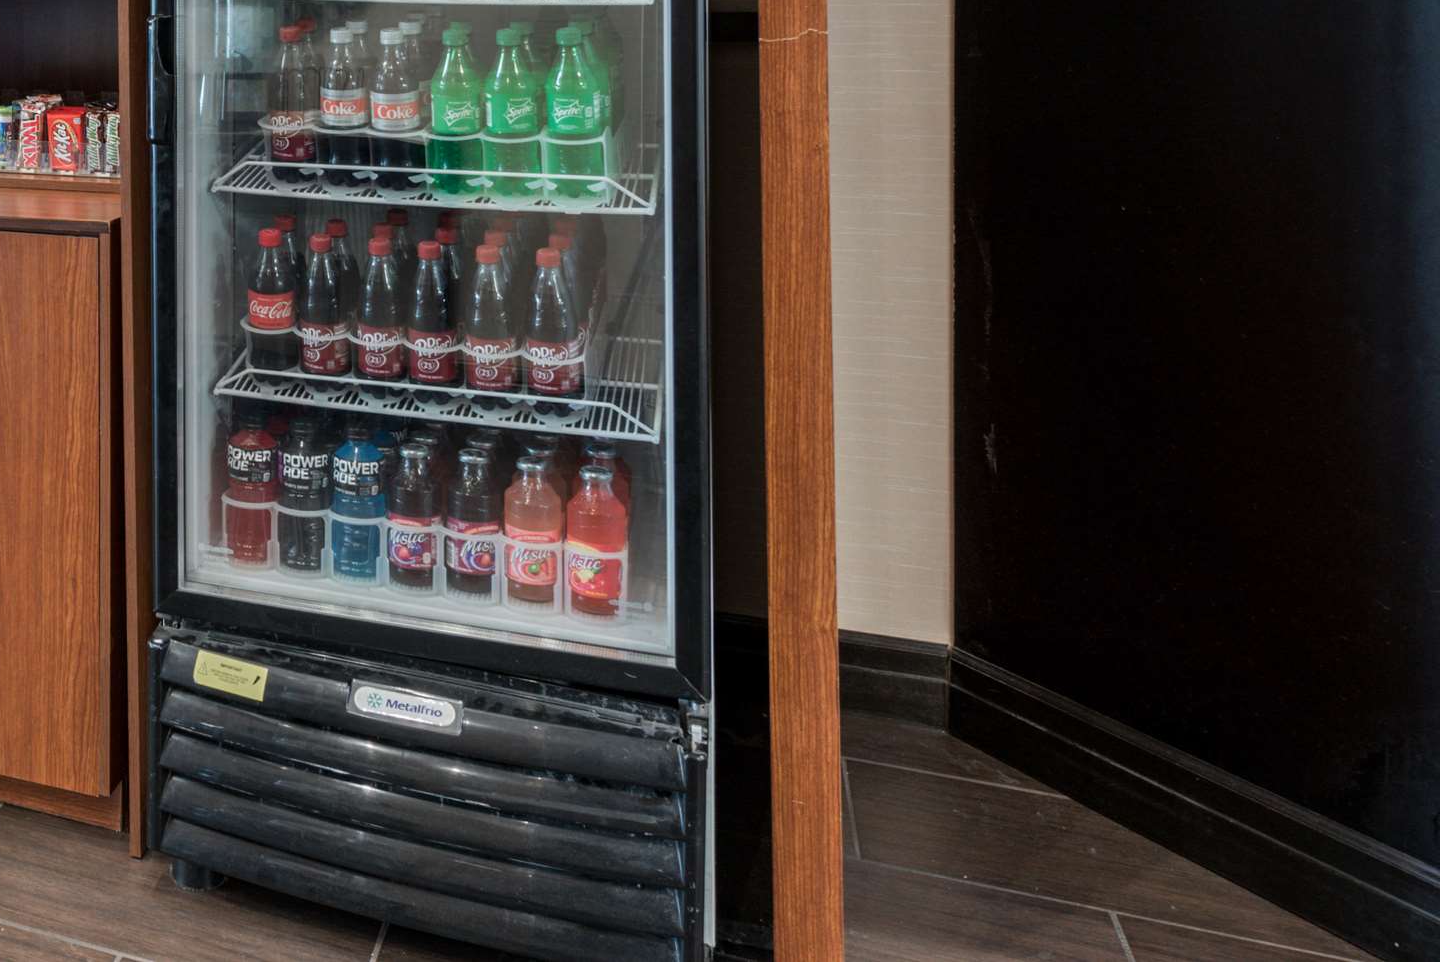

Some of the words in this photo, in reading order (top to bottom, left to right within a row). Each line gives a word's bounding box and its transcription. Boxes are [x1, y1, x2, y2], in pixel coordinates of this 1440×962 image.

[322, 99, 357, 115] Coke
[377, 105, 414, 120] Coke
[446, 107, 473, 120] Sprite
[555, 105, 582, 118] Sprite
[249, 300, 292, 320] Coca-Cola
[227, 445, 271, 463] POWER
[283, 452, 328, 468] POWER
[333, 456, 379, 475] POWER
[385, 698, 443, 718] Metalfrio
